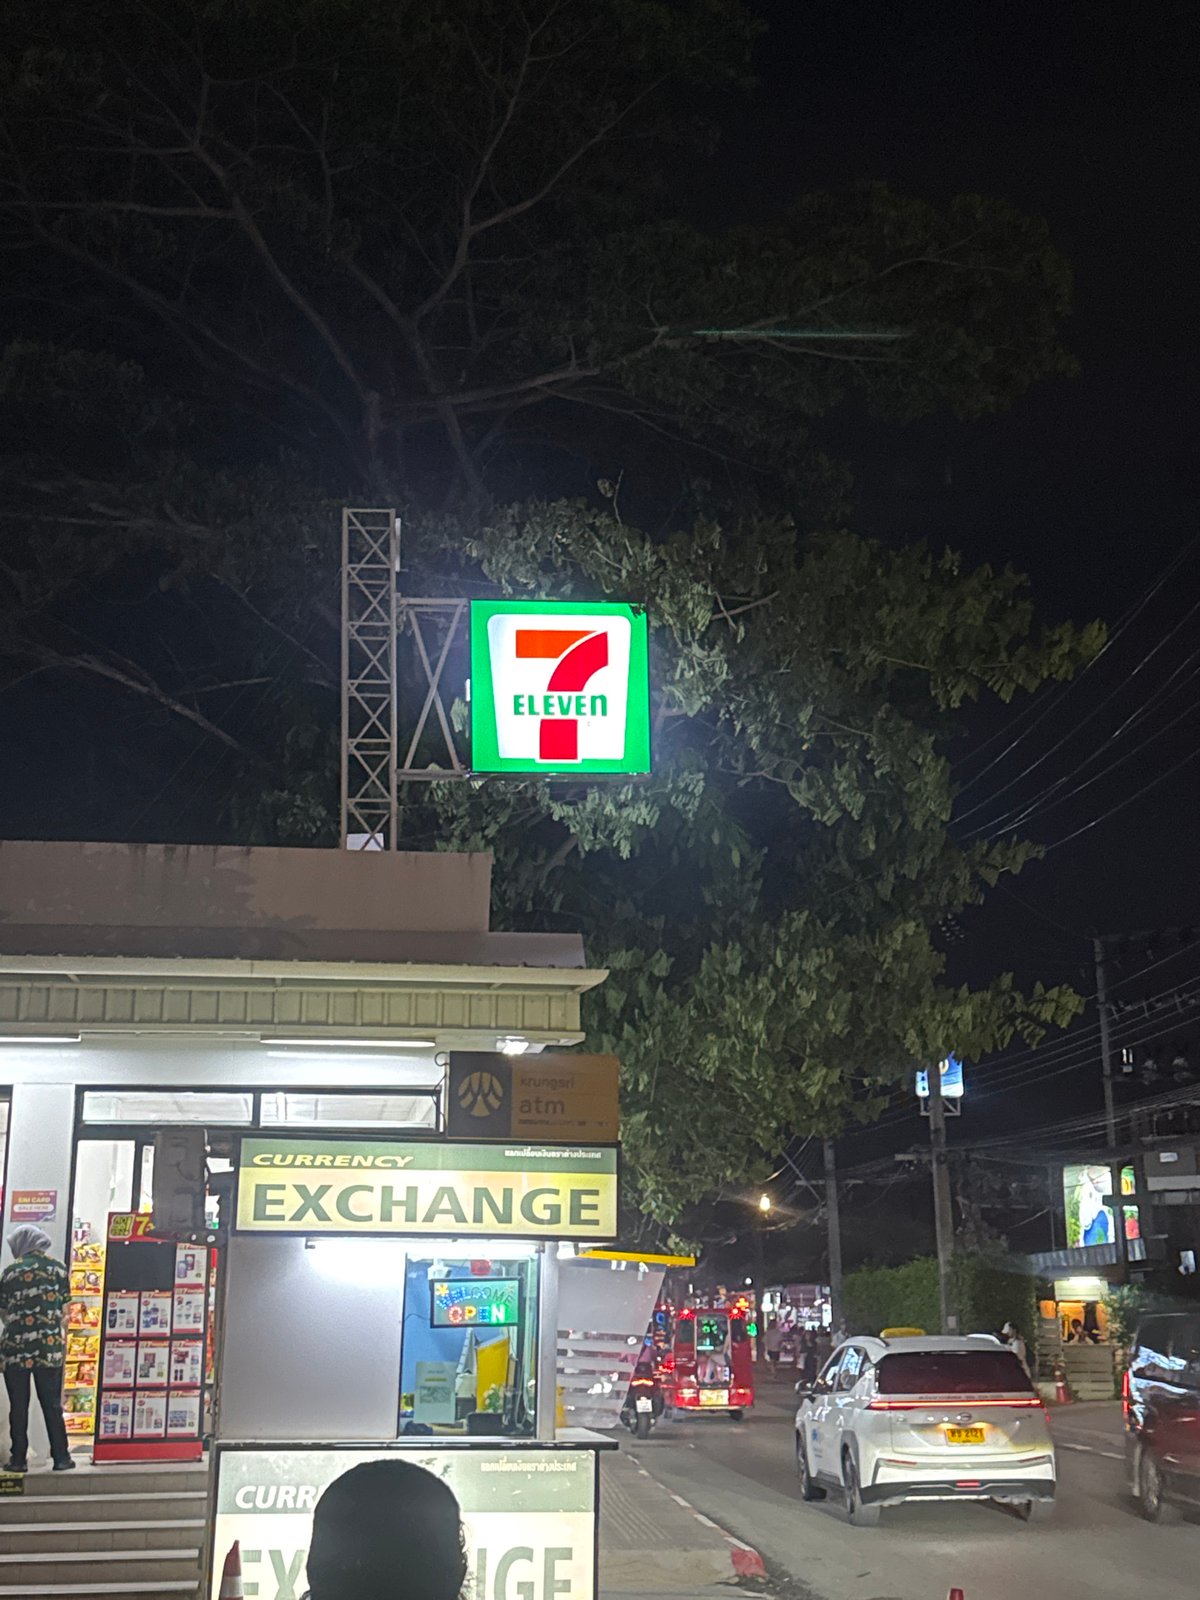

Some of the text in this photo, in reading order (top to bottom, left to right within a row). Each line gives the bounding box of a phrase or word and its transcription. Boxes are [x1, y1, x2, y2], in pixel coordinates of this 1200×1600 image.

[515, 629, 608, 760] 7
[520, 1096, 565, 1115] atm
[252, 1153, 414, 1168] CURRENCY
[252, 1182, 601, 1226] EXCHANGE
[448, 1302, 506, 1325] OPEN
